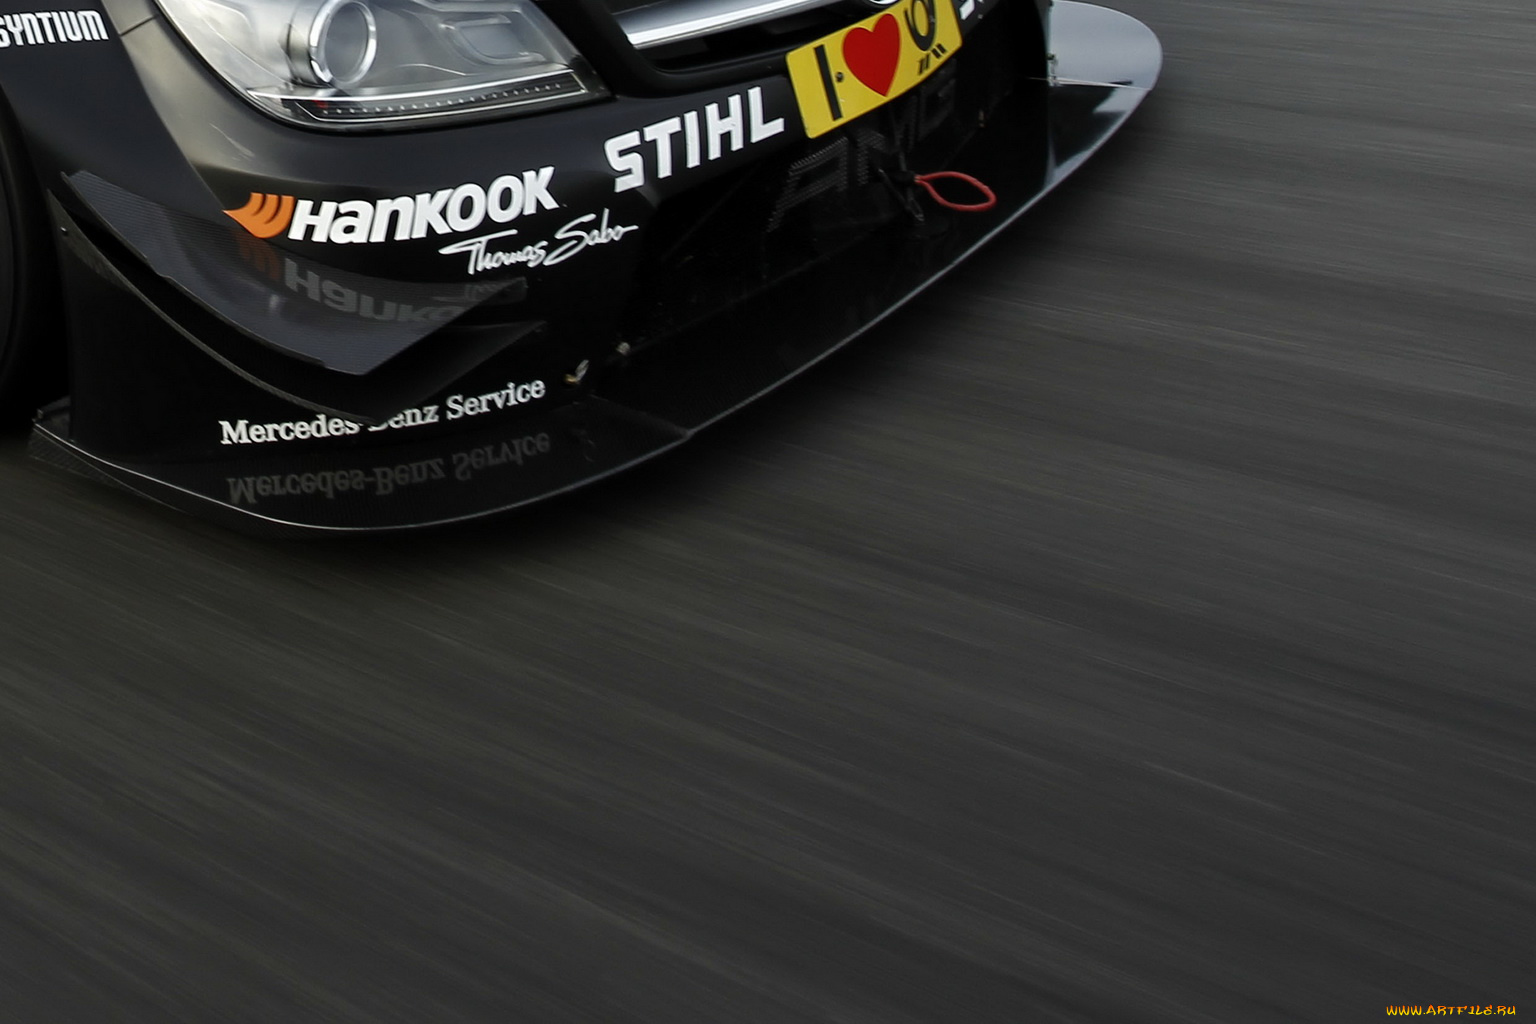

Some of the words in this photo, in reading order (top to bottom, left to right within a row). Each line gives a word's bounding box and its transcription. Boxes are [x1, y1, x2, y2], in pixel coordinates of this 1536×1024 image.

[604, 86, 785, 193] STIHL
[438, 229, 548, 275] Thomas
[543, 208, 639, 267] Sabo
[218, 403, 439, 445] Mercedes-enz
[446, 379, 546, 421] Service
